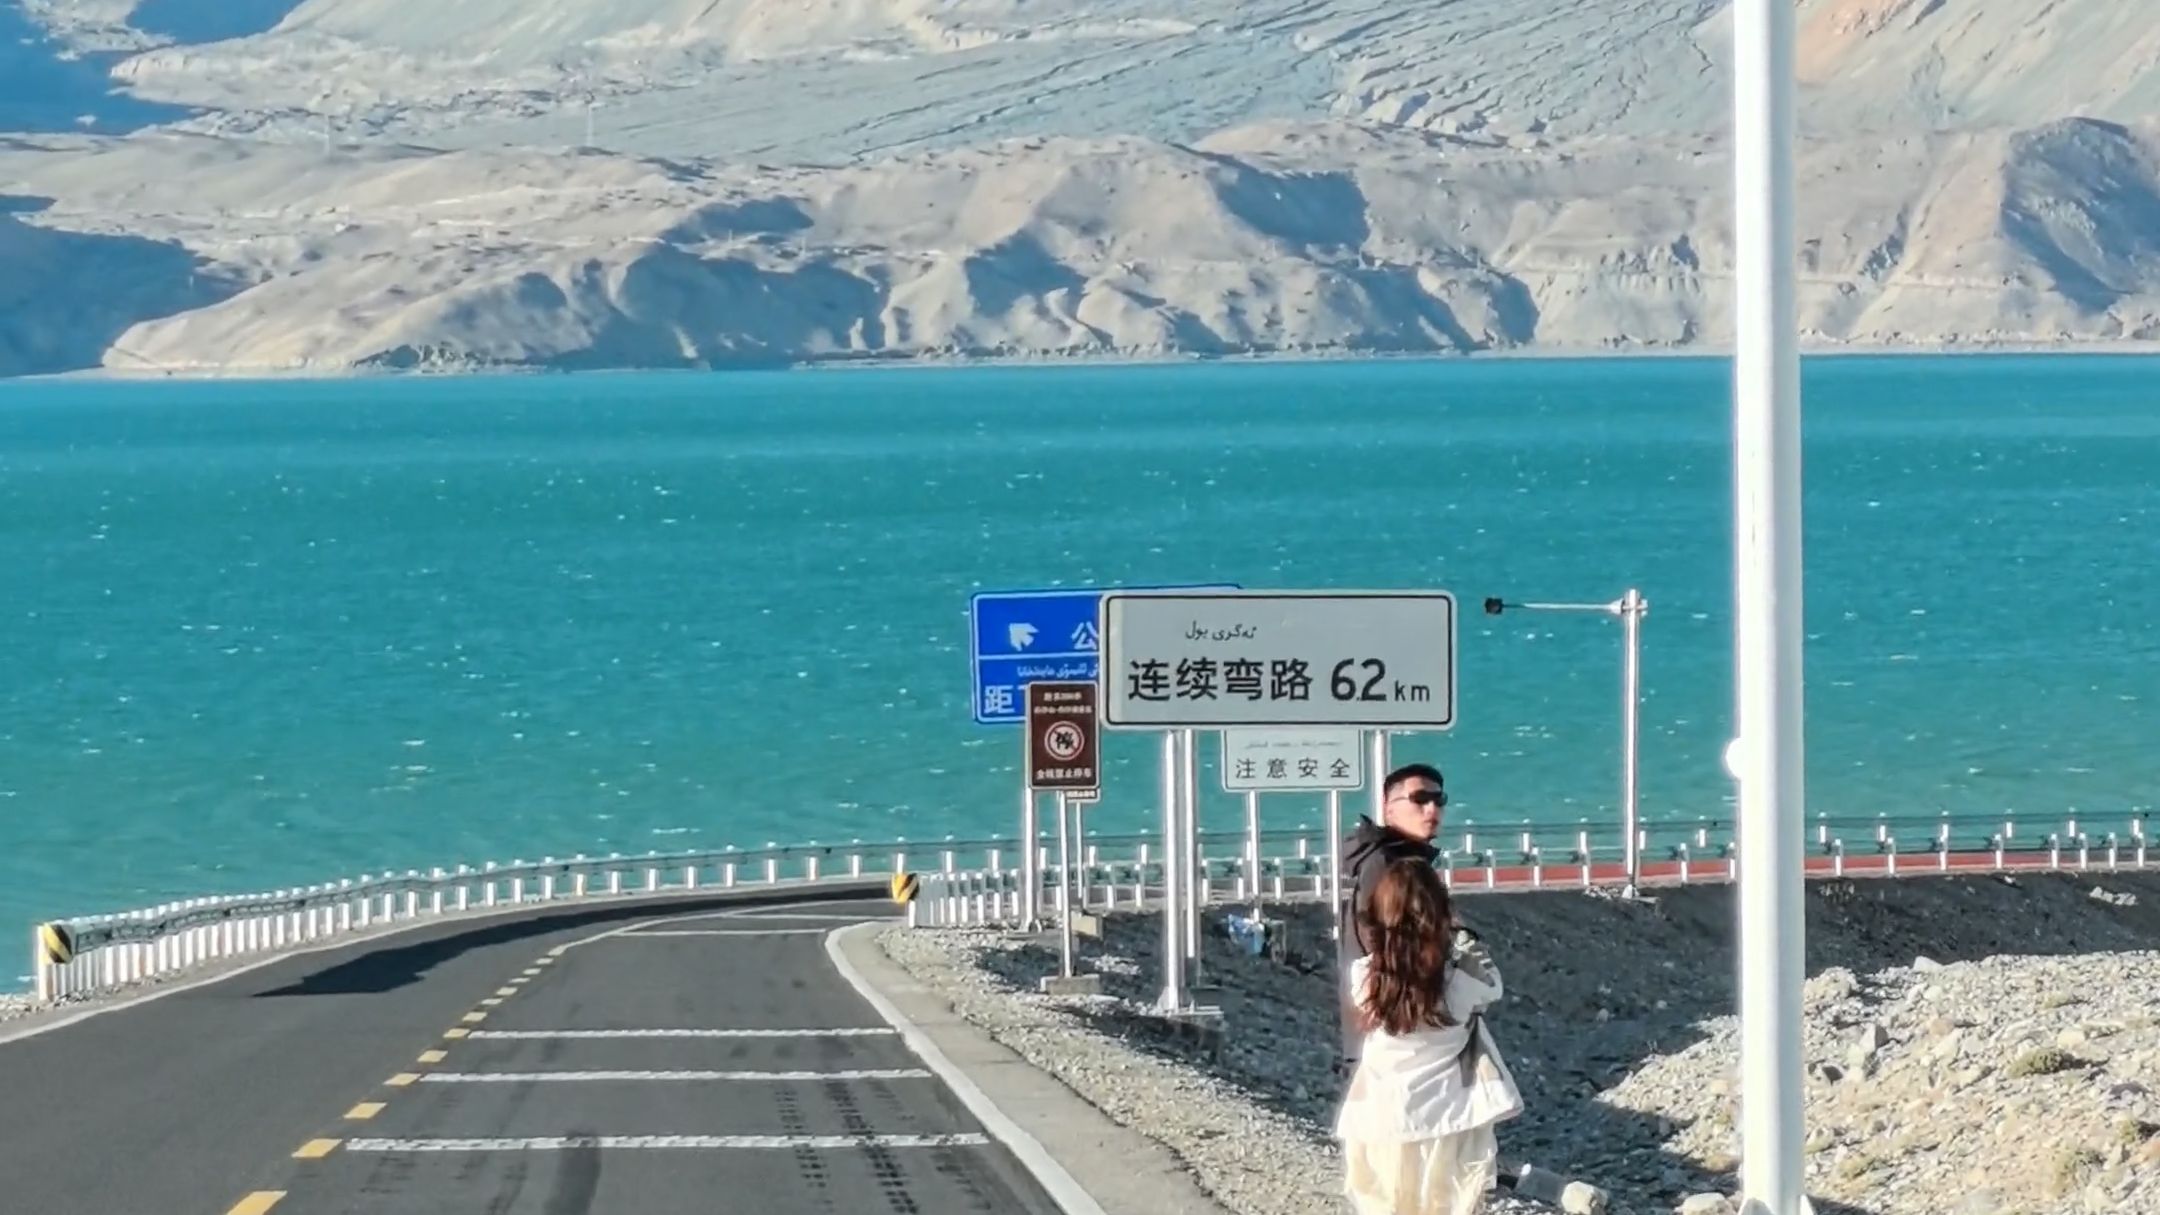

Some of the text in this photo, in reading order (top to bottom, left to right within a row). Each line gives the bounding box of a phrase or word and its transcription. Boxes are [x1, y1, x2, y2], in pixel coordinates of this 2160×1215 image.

[1128, 657, 1314, 701] 连续弯路
[1235, 756, 1351, 779] 注意安全
